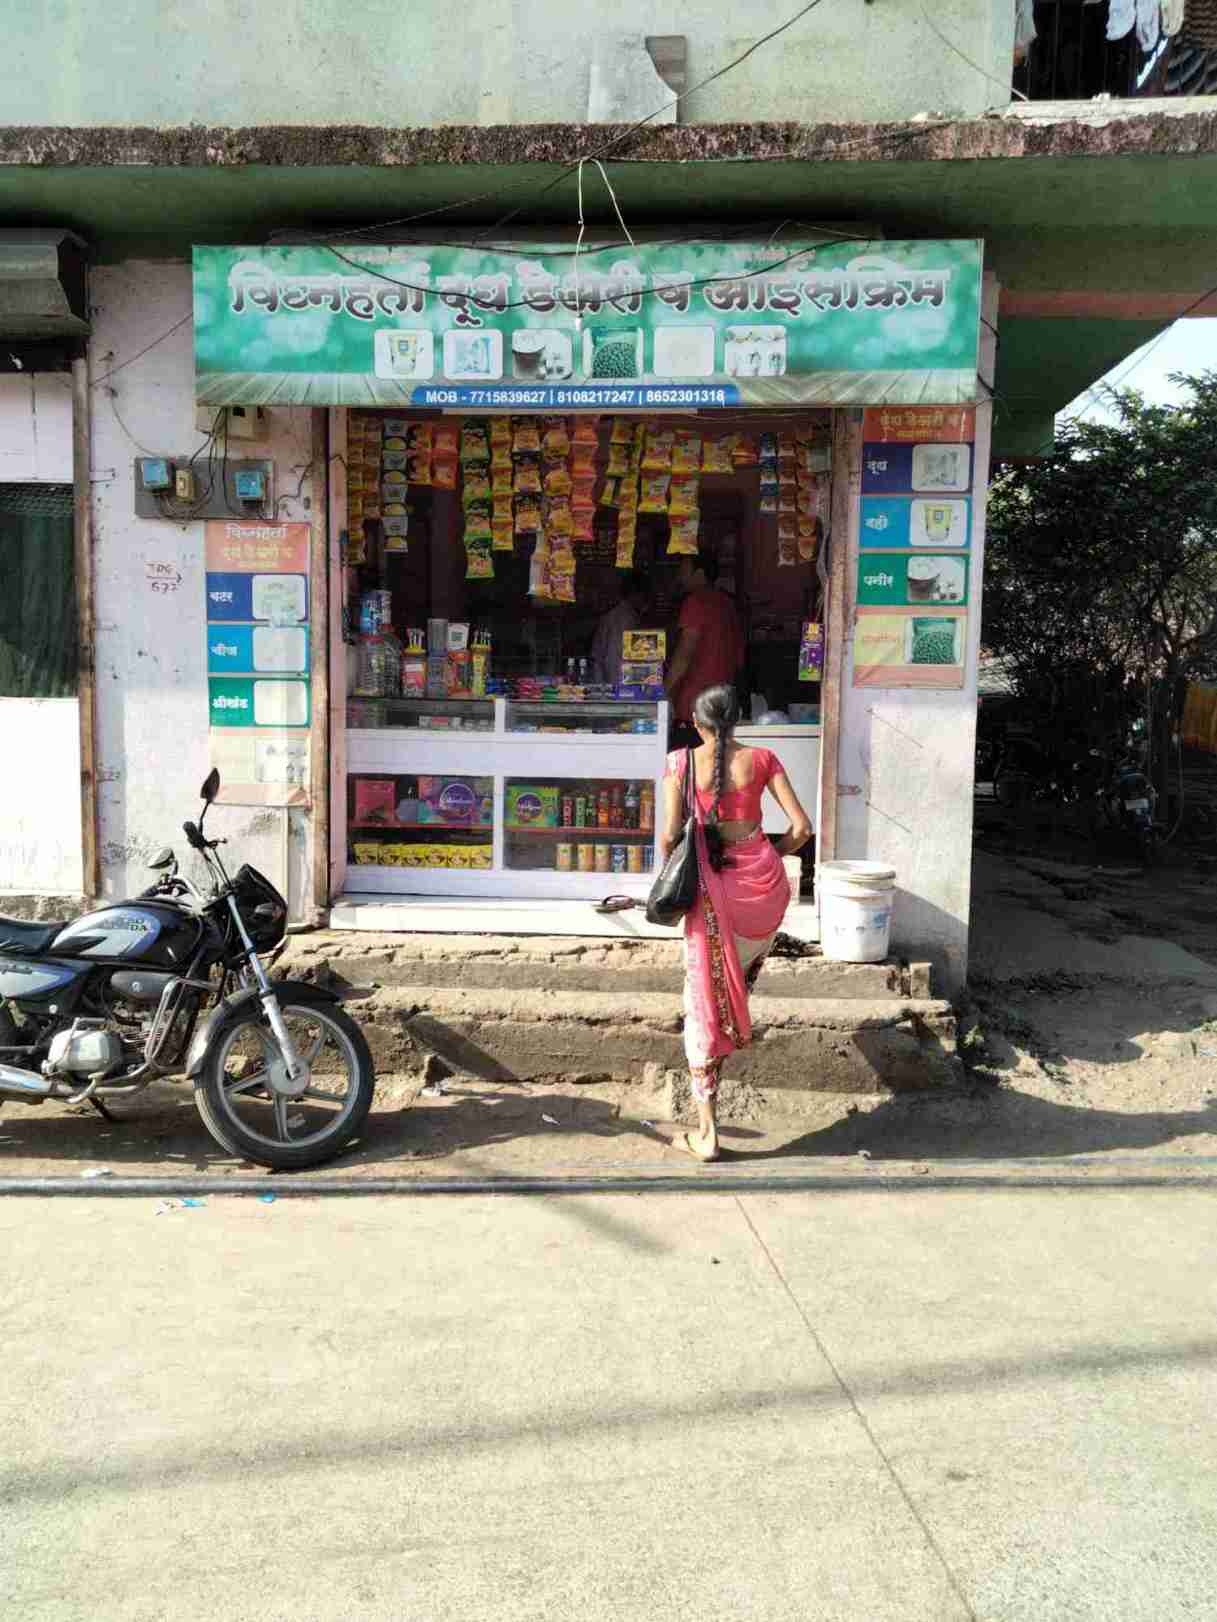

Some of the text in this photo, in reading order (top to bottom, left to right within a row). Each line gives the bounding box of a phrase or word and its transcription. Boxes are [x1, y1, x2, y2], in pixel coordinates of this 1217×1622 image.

[436, 273, 512, 326] दूध
[652, 272, 693, 312] व
[425, 390, 458, 403] MOB
[557, 389, 635, 403] 8108217247
[864, 459, 888, 475] दूध
[863, 571, 894, 589] पनीर
